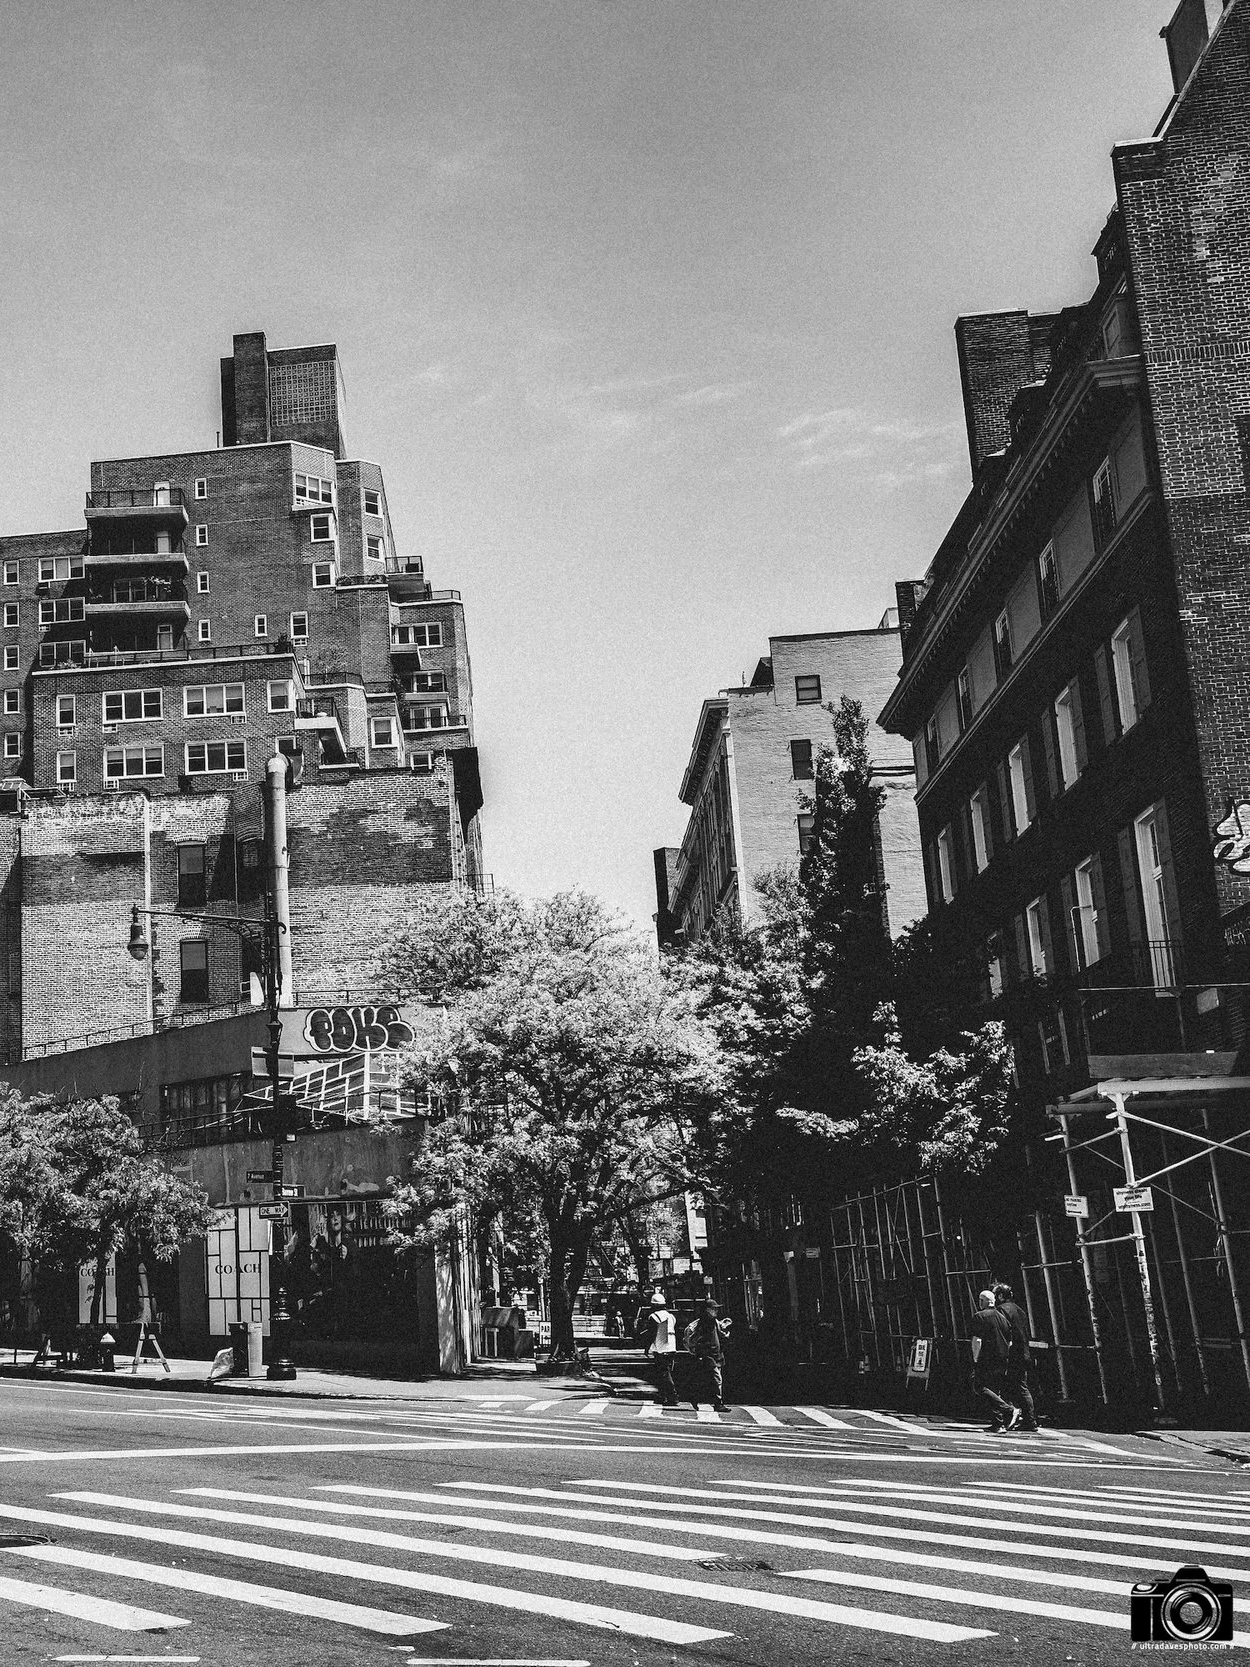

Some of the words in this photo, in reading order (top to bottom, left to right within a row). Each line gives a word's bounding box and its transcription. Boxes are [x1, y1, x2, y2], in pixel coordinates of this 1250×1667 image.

[261, 1207, 270, 1215] ONE
[80, 1267, 115, 1277] COH
[215, 1263, 262, 1275] COACH
